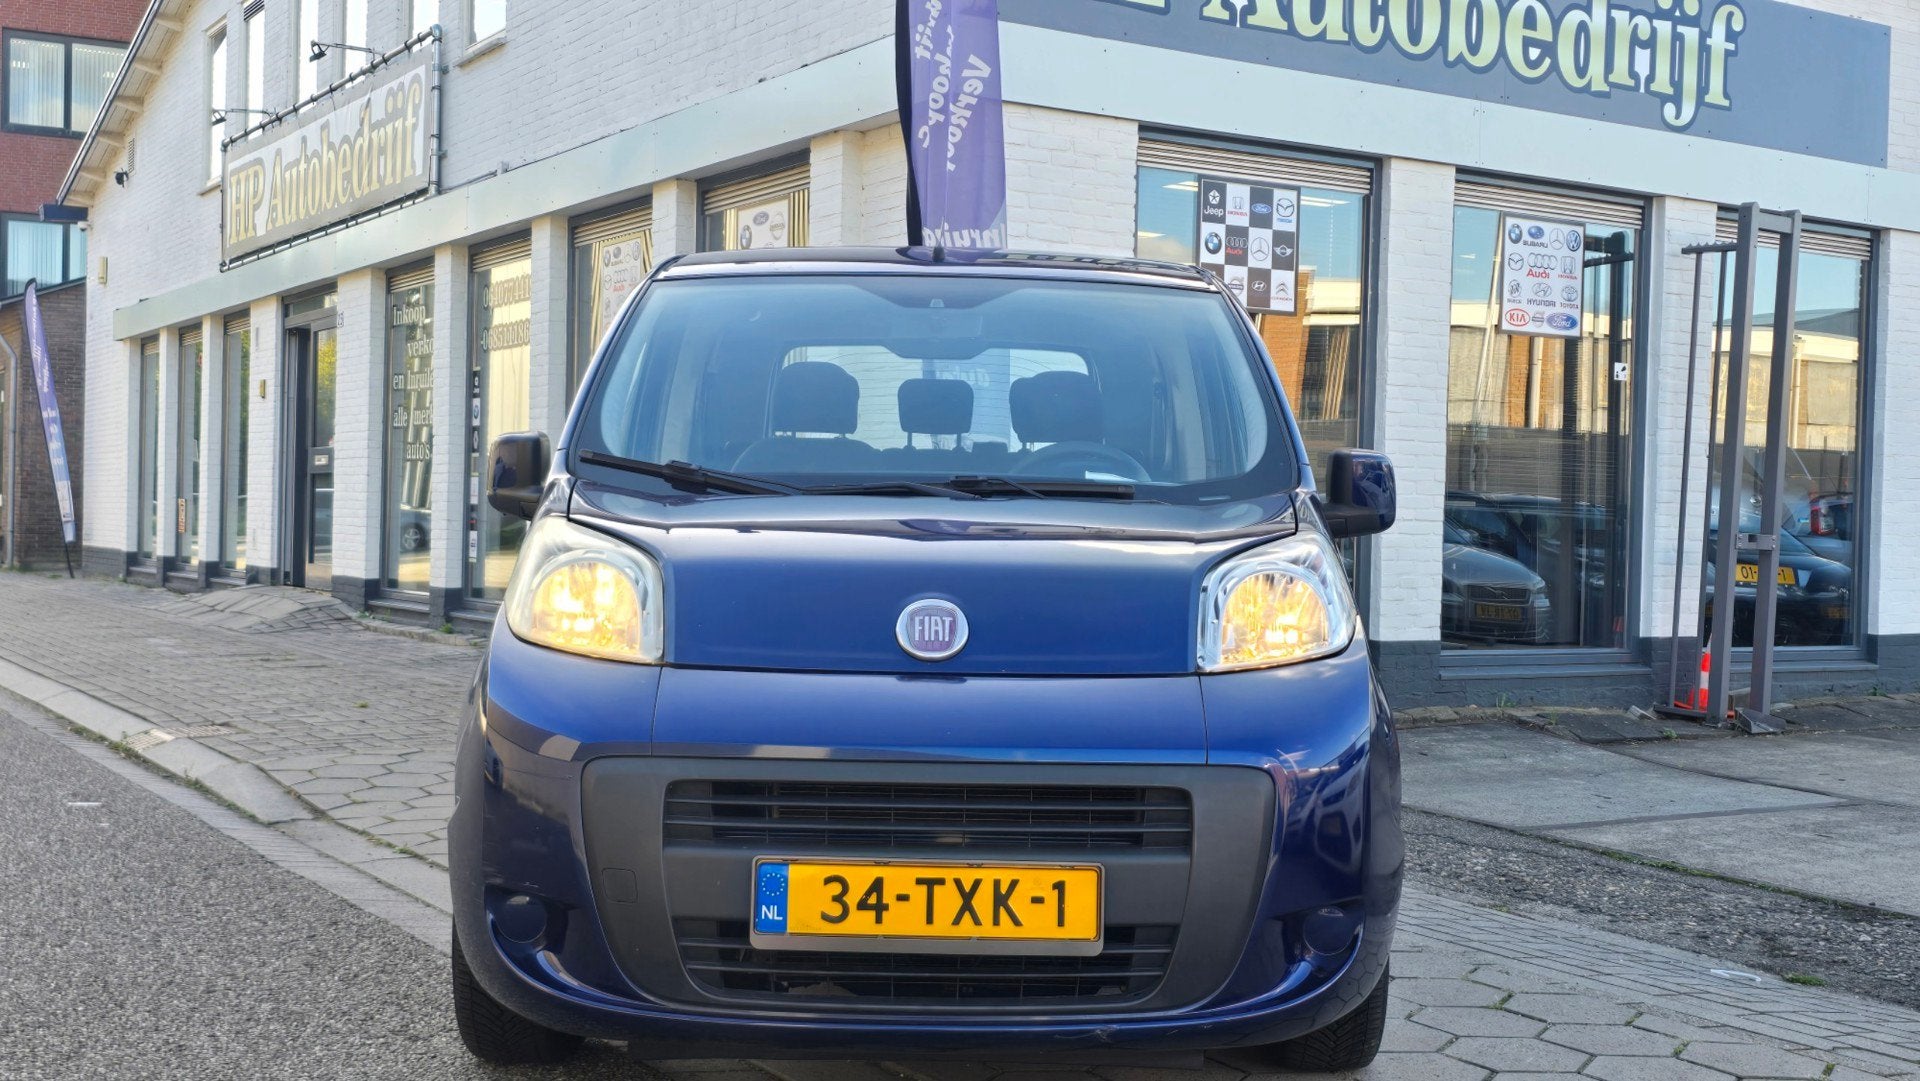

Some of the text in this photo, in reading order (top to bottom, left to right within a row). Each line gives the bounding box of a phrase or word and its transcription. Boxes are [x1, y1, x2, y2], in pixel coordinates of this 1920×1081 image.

[229, 163, 264, 244] HP
[1204, 205, 1224, 218] Jeep
[1523, 239, 1549, 249] SUBARU
[1526, 268, 1550, 279] Audi
[1526, 298, 1556, 307] HYUNDAI
[393, 304, 426, 326] Inkoop
[1509, 312, 1526, 322] KIA
[393, 374, 405, 390] en
[393, 405, 408, 428] alle
[914, 616, 953, 642] FIAT
[761, 873, 1066, 928] NL 34-TXK-1
